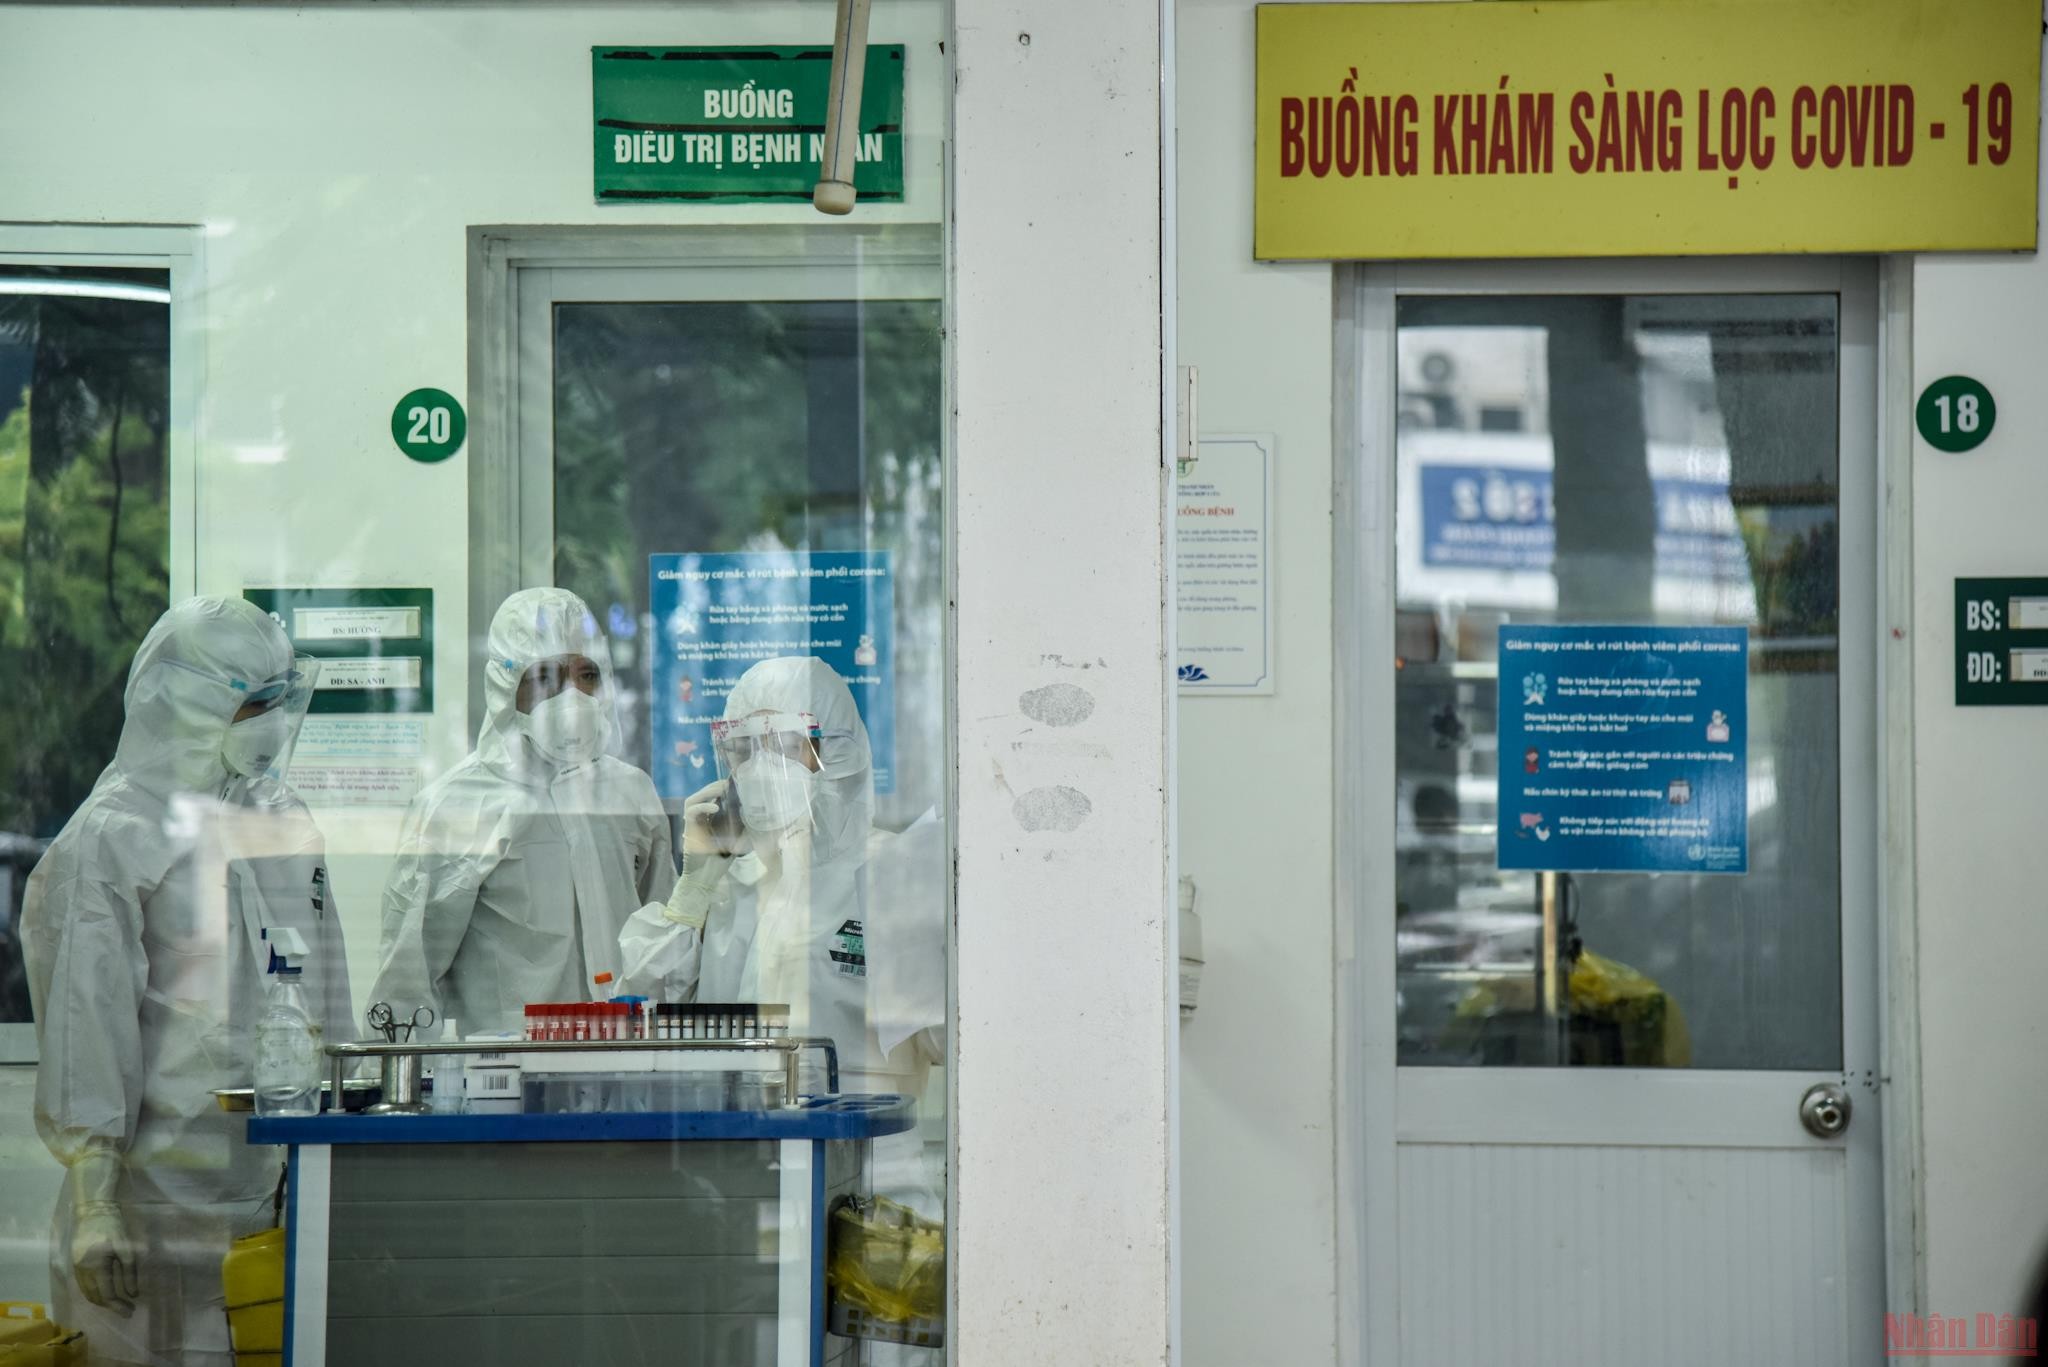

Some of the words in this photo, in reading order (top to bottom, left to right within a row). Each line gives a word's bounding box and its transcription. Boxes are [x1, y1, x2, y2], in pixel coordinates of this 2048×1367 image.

[704, 79, 793, 118] BUỒNG
[1280, 67, 1418, 178] BUỒNG
[1433, 75, 1554, 175] KHÁM
[1568, 73, 1682, 172] SÀNG
[1698, 87, 1775, 189] LỌC
[1791, 84, 1914, 169] COVID
[1962, 81, 2012, 166] 19
[682, 134, 722, 169] TRỊ
[407, 406, 450, 444] 20
[1935, 394, 1979, 432] 18
[1966, 600, 2001, 631] BS:
[1967, 652, 2002, 683] ĐD:
